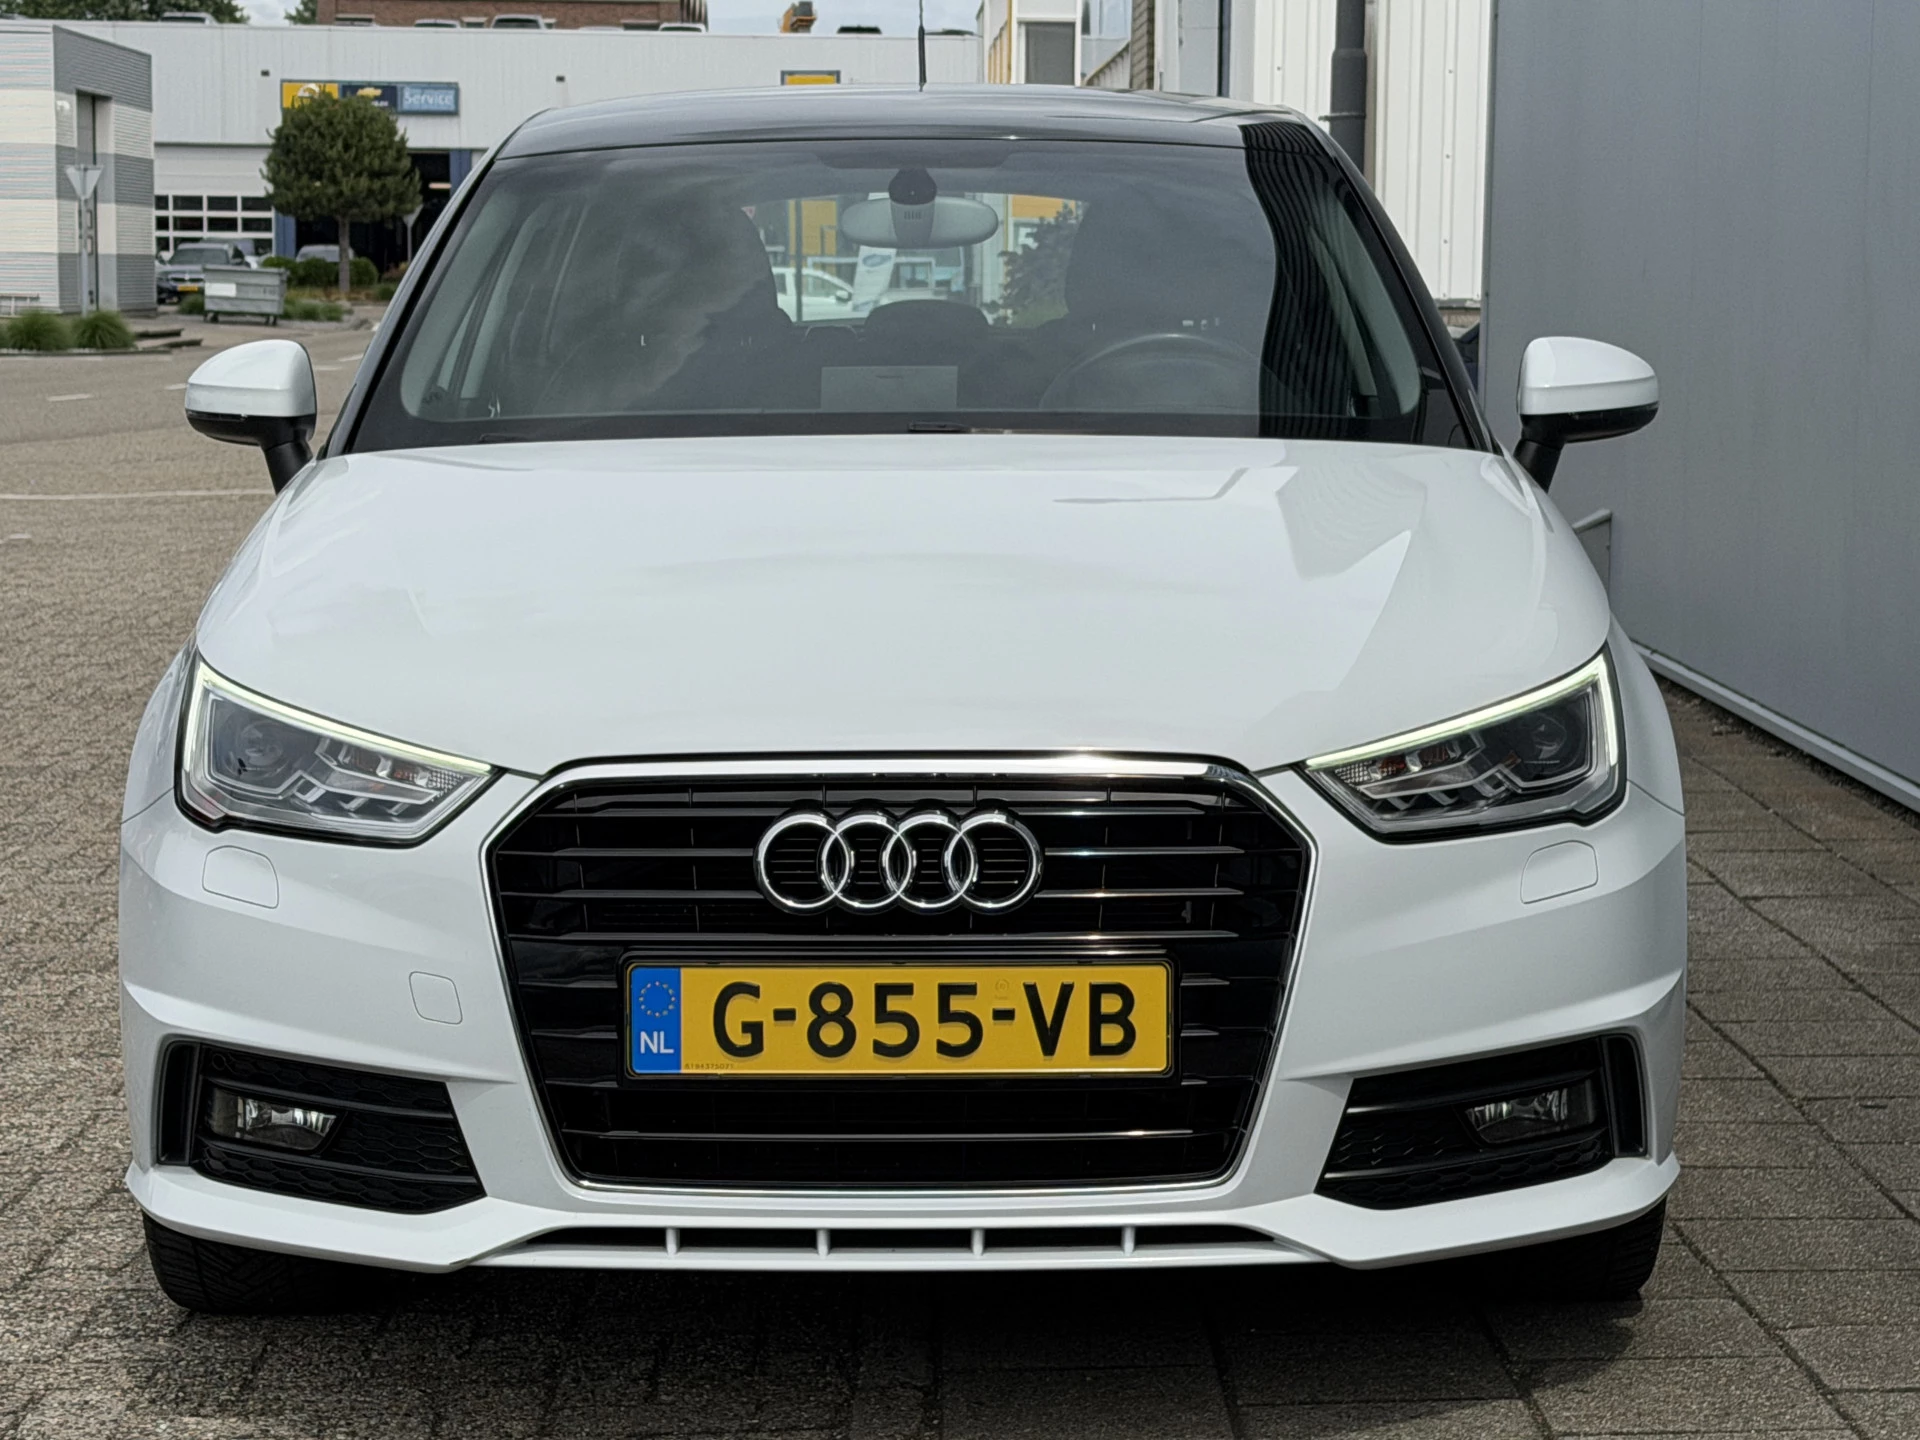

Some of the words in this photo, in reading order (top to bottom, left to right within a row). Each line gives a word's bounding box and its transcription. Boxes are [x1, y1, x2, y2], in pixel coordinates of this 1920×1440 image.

[403, 86, 454, 105] Service
[713, 981, 1137, 1058] G-855-VB
[639, 1031, 675, 1054] NL
